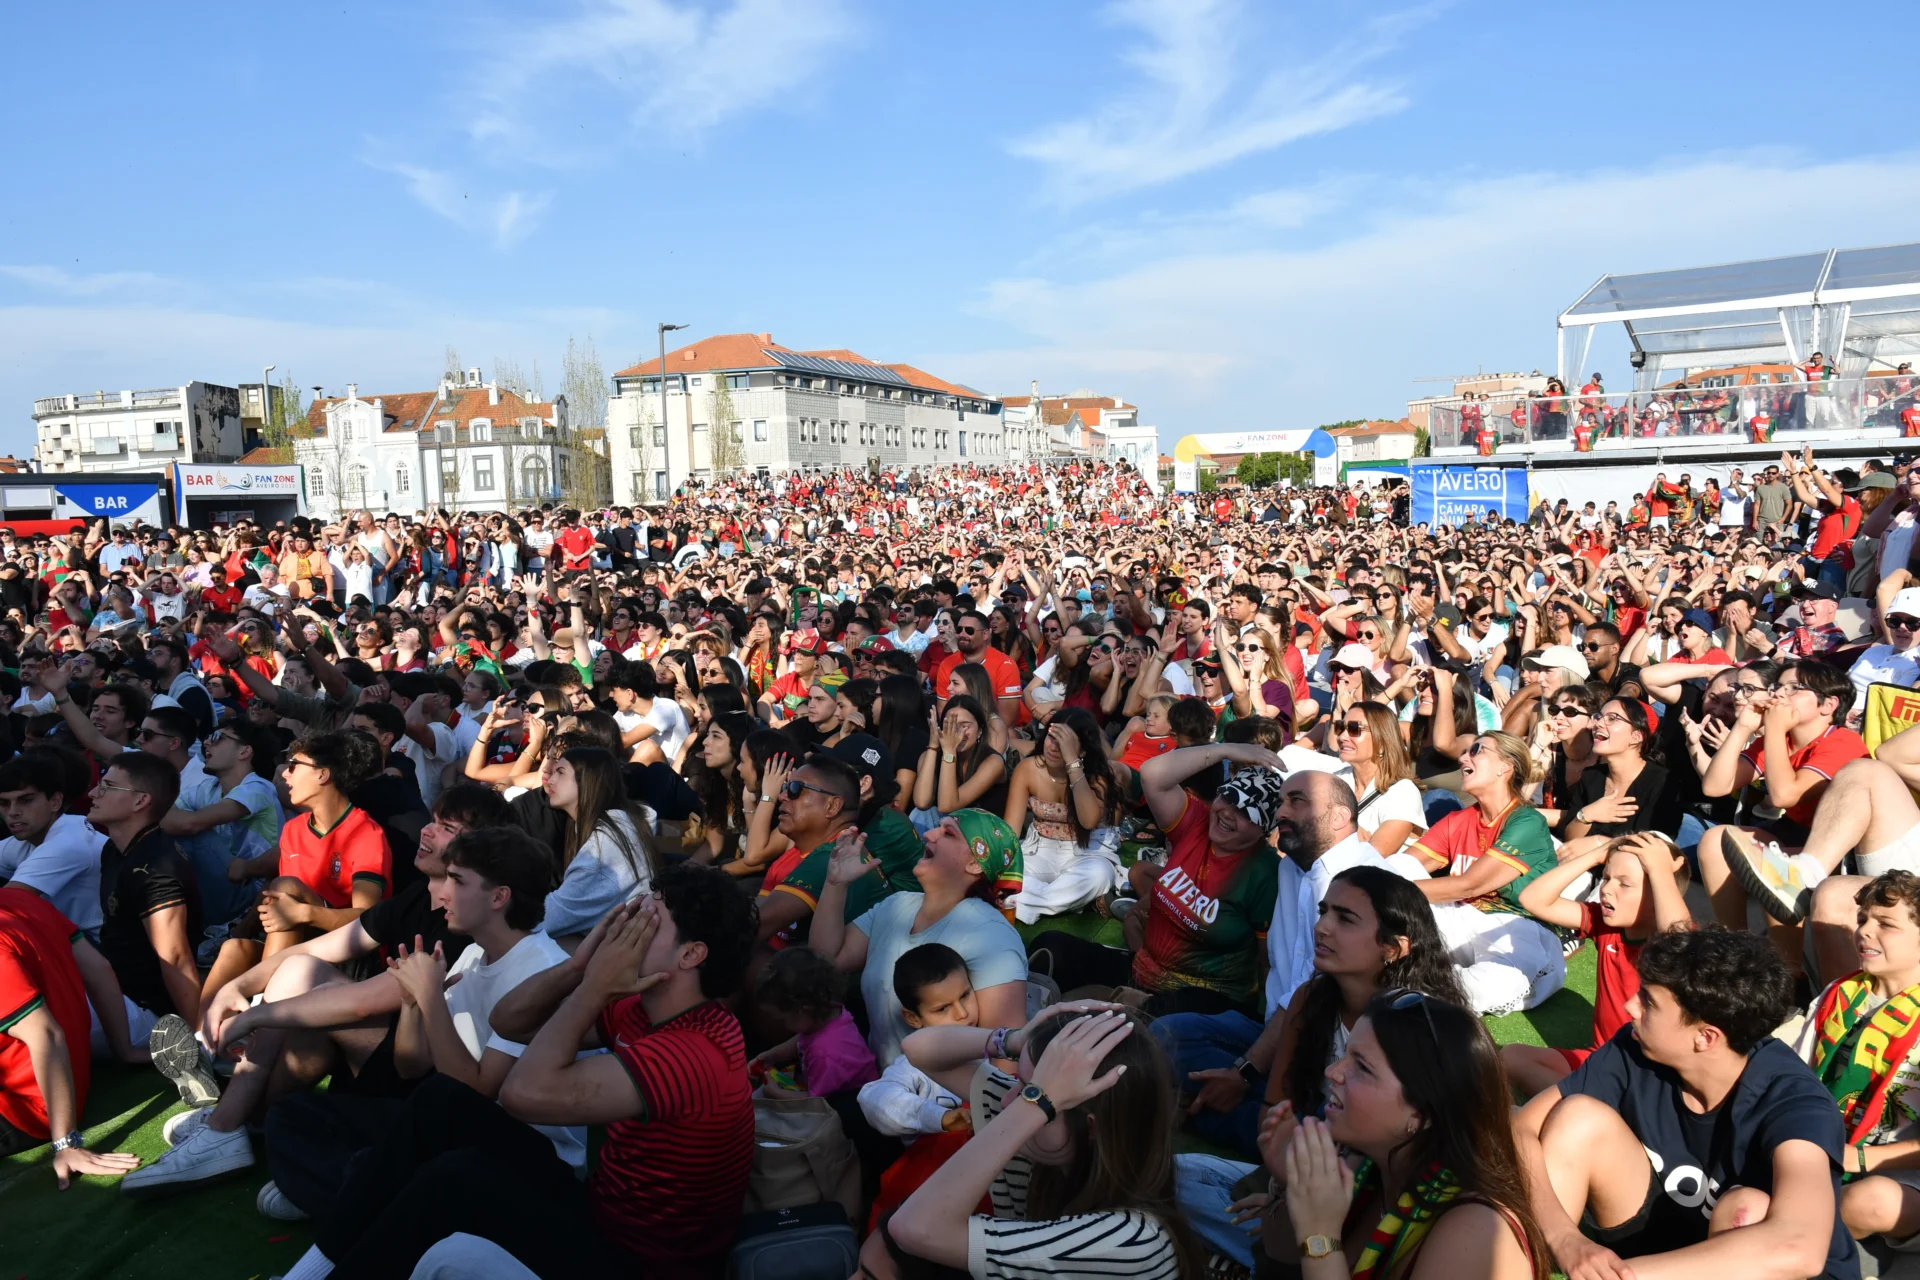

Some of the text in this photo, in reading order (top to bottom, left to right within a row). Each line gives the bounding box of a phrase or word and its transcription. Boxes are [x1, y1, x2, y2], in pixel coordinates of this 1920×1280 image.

[186, 475, 214, 486] BAR
[255, 475, 295, 483] FAN ZONE
[1438, 473, 1501, 491] AVEIRO
[94, 496, 128, 509] BAR
[1157, 891, 1182, 919] MUNDIAL
[1182, 915, 1199, 931] 2026
